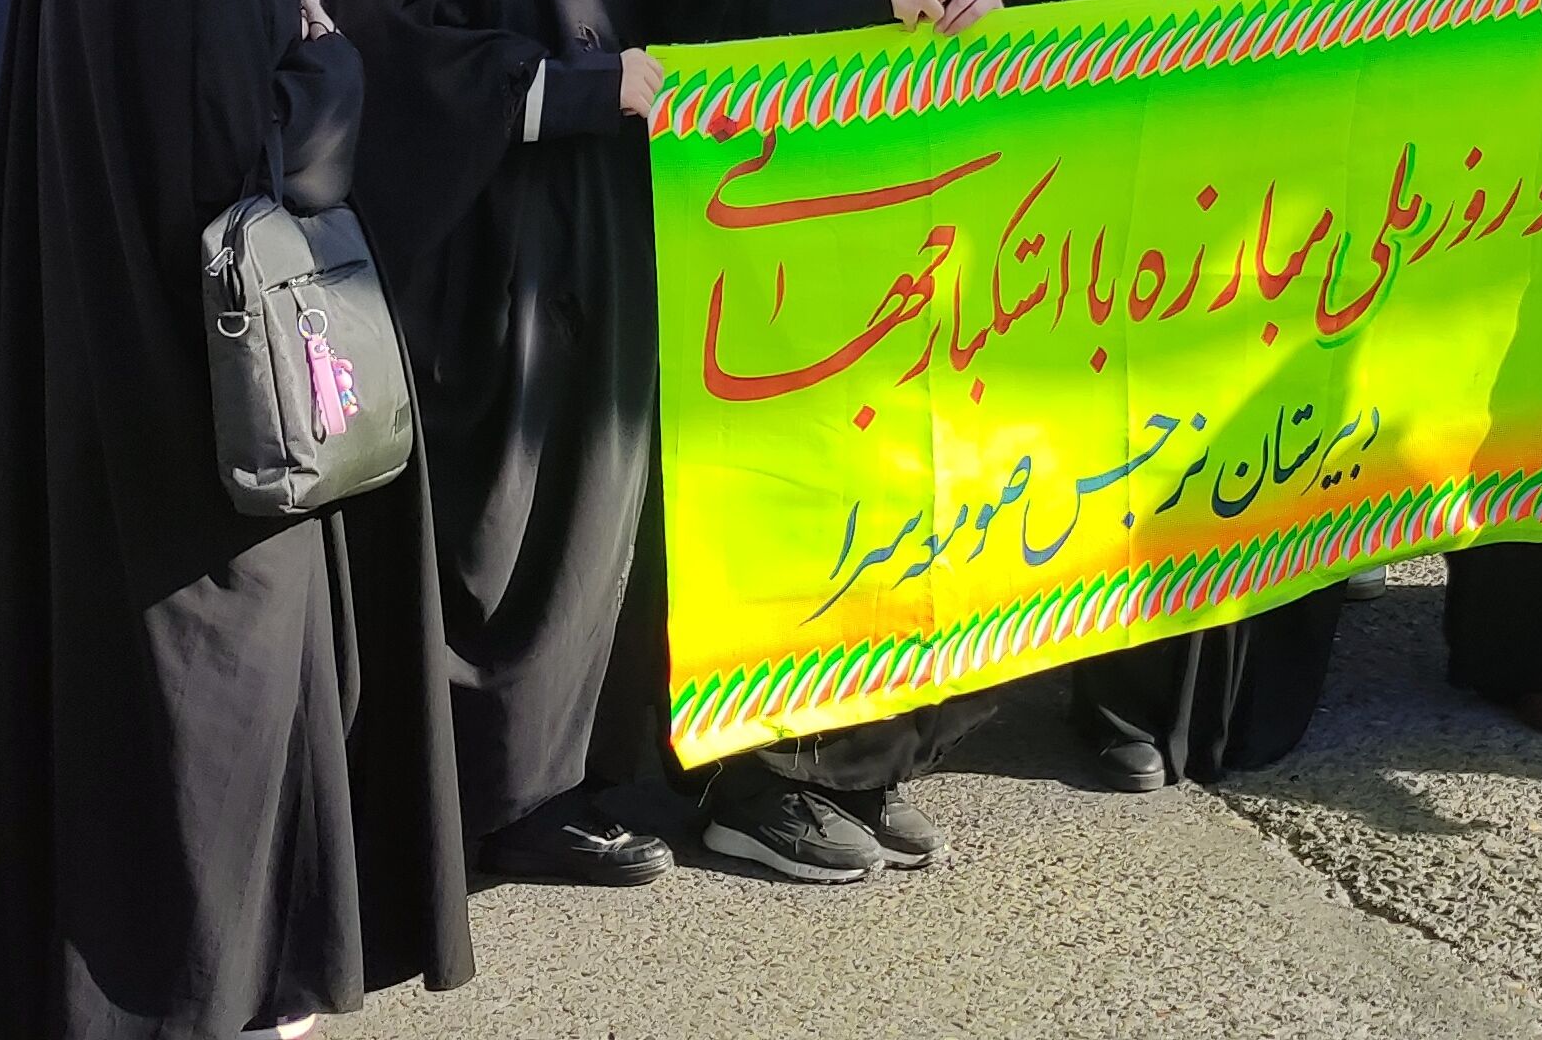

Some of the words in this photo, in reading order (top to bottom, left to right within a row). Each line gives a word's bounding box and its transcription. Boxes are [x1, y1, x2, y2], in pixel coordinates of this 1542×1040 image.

[702, 113, 1003, 433] جهانی
[893, 156, 1073, 406] استکبار
[1128, 179, 1334, 347] مبارزه
[1315, 142, 1432, 349] ملی
[1407, 146, 1523, 265] روز
[1087, 224, 1117, 374] با
[891, 454, 1033, 591] صومعه
[1021, 411, 1209, 569] نرجس
[1210, 403, 1380, 520] دبیرستان
[799, 500, 923, 627] سرا
